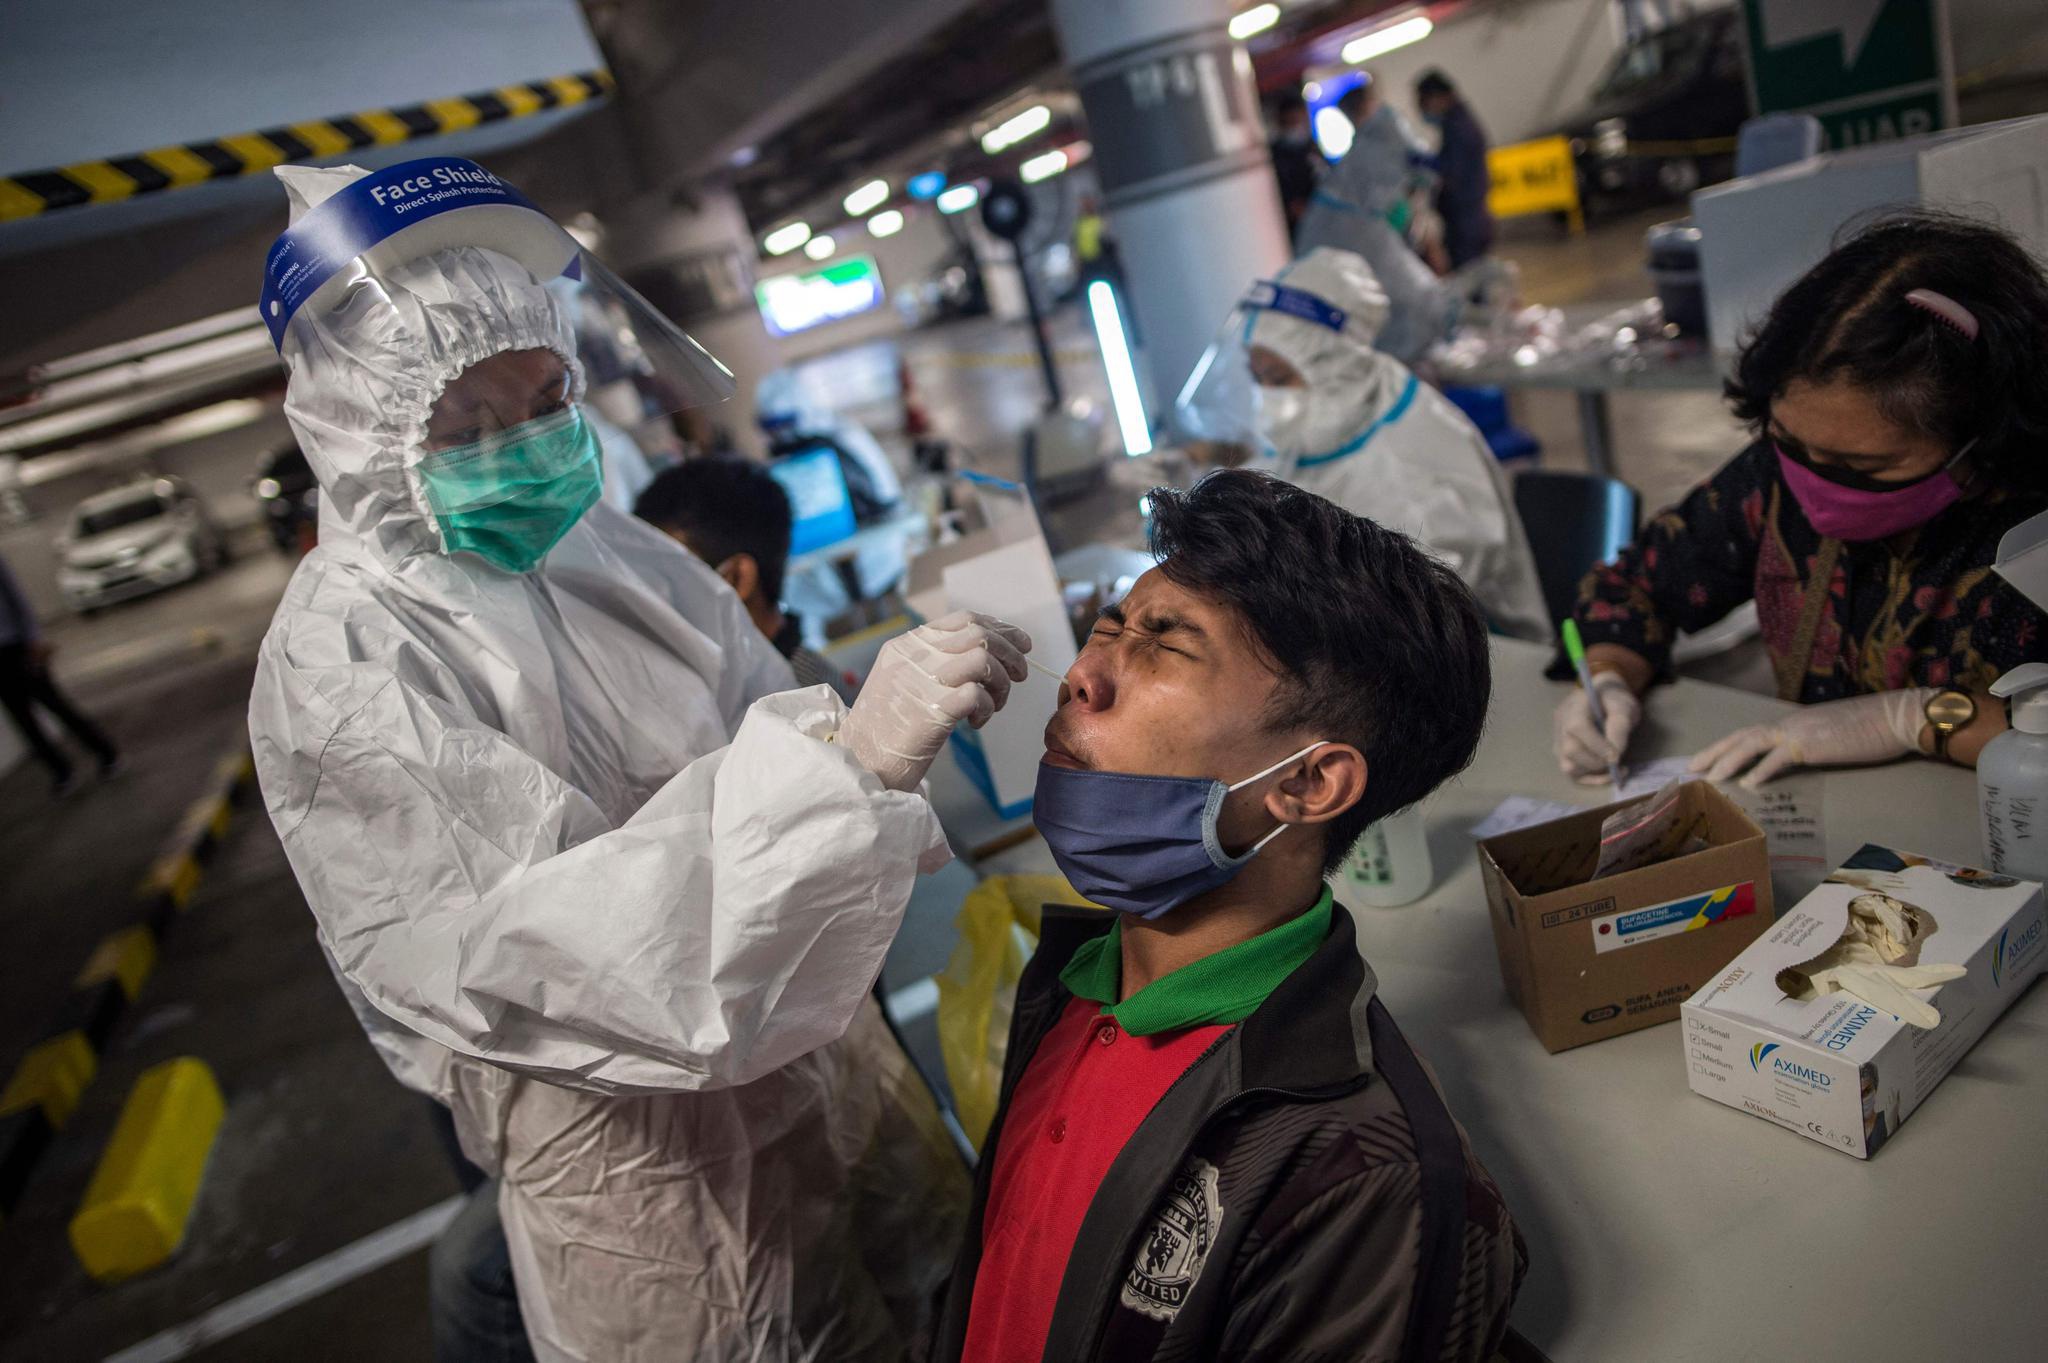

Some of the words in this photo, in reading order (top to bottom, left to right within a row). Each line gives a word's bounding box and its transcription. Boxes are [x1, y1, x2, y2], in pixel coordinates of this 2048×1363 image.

[370, 176, 432, 206] Face
[432, 167, 502, 187] Shield
[394, 196, 428, 214] Direct
[427, 188, 462, 202] Splash
[461, 186, 506, 196] Protection
[278, 262, 300, 290] WARNING
[1546, 915, 1560, 925] ISI
[1569, 909, 1581, 918] 24
[1583, 901, 1612, 916] TUBE
[1620, 908, 1669, 925] BUFACETINE
[2008, 919, 2042, 960] AXIMED
[1717, 966, 1745, 992] AXION
[1700, 1022, 1730, 1040] X-Small
[1827, 1006, 1877, 1050] AXIMED
[1702, 1038, 1722, 1052] Small
[1703, 1053, 1734, 1070] Medium
[1704, 1068, 1726, 1082] Large
[1774, 1058, 1831, 1086] AXIMED
[1744, 1100, 1776, 1118] AXION
[1175, 1177, 1208, 1247] CHESTER
[1128, 1271, 1180, 1301] NITED
